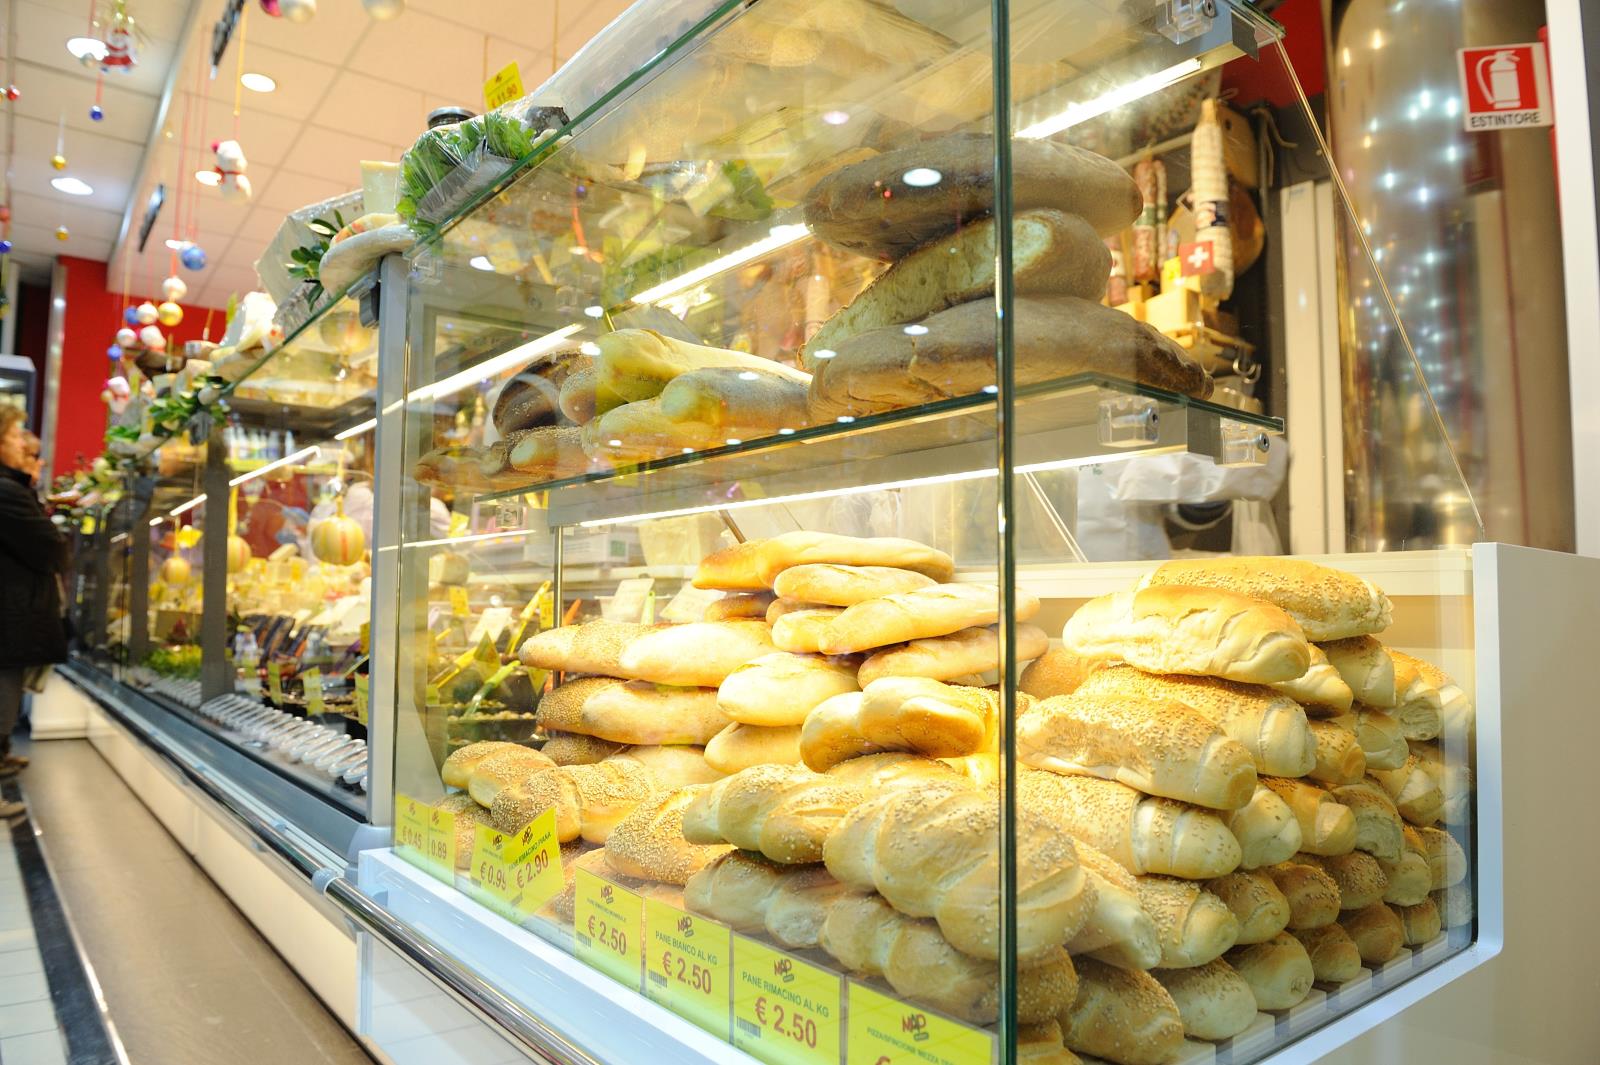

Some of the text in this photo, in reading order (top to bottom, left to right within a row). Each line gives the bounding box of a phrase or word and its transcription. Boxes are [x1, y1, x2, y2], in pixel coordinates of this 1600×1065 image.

[1471, 112, 1541, 128] ESTINTORE
[480, 861, 487, 881] €
[517, 869, 525, 889] €
[526, 849, 549, 882] 2.90
[588, 914, 627, 956] € 2.50
[655, 930, 672, 947] PANE
[673, 937, 696, 955] BIANCO
[697, 948, 707, 961] AL
[707, 953, 718, 966] KG
[662, 951, 712, 995] € 2.50
[742, 971, 762, 989] PANE
[763, 980, 802, 1006] RIMACINO
[803, 998, 815, 1012] AL
[816, 1002, 829, 1018] KG
[755, 996, 817, 1049] € 2.50
